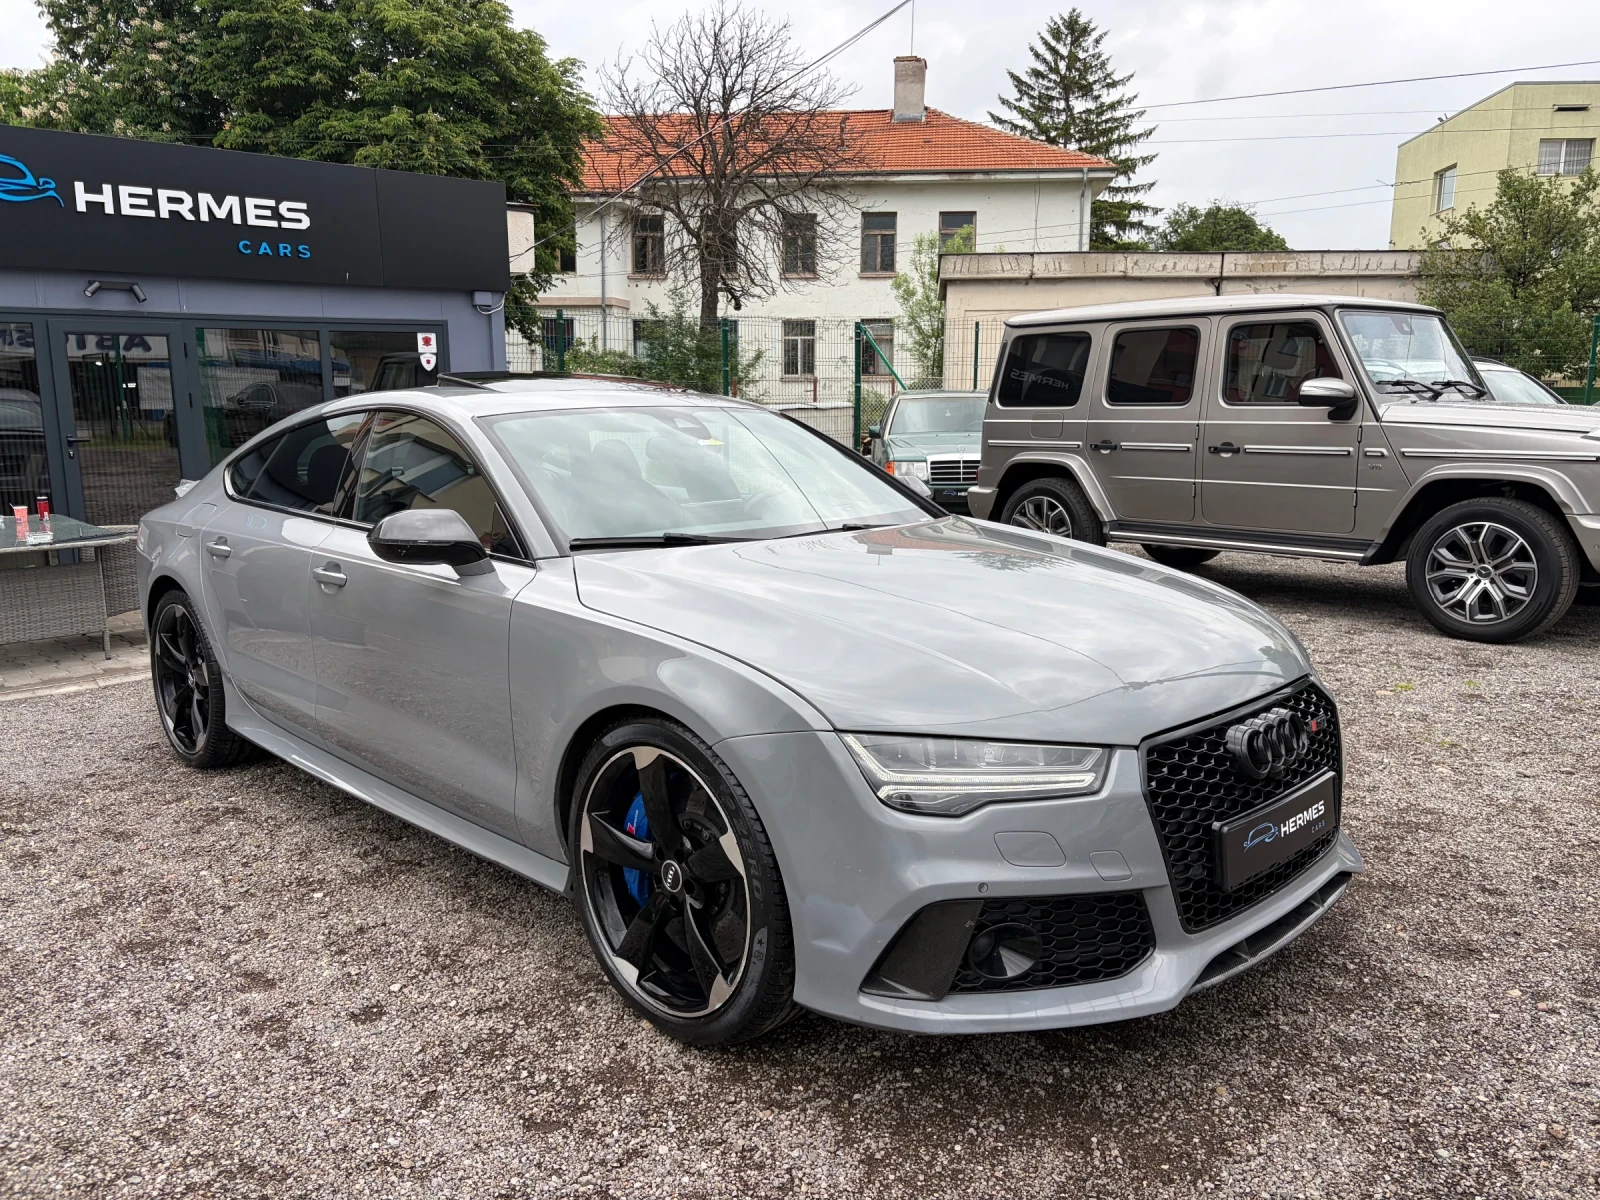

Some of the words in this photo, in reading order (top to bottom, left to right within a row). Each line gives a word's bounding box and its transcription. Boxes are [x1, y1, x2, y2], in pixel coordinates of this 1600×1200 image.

[74, 180, 311, 230] HERMES
[237, 240, 311, 259] CARS
[1367, 463, 1382, 471] V8
[1280, 799, 1325, 838] HERMES
[1311, 819, 1326, 834] CARS
[732, 816, 764, 903] ZERO
